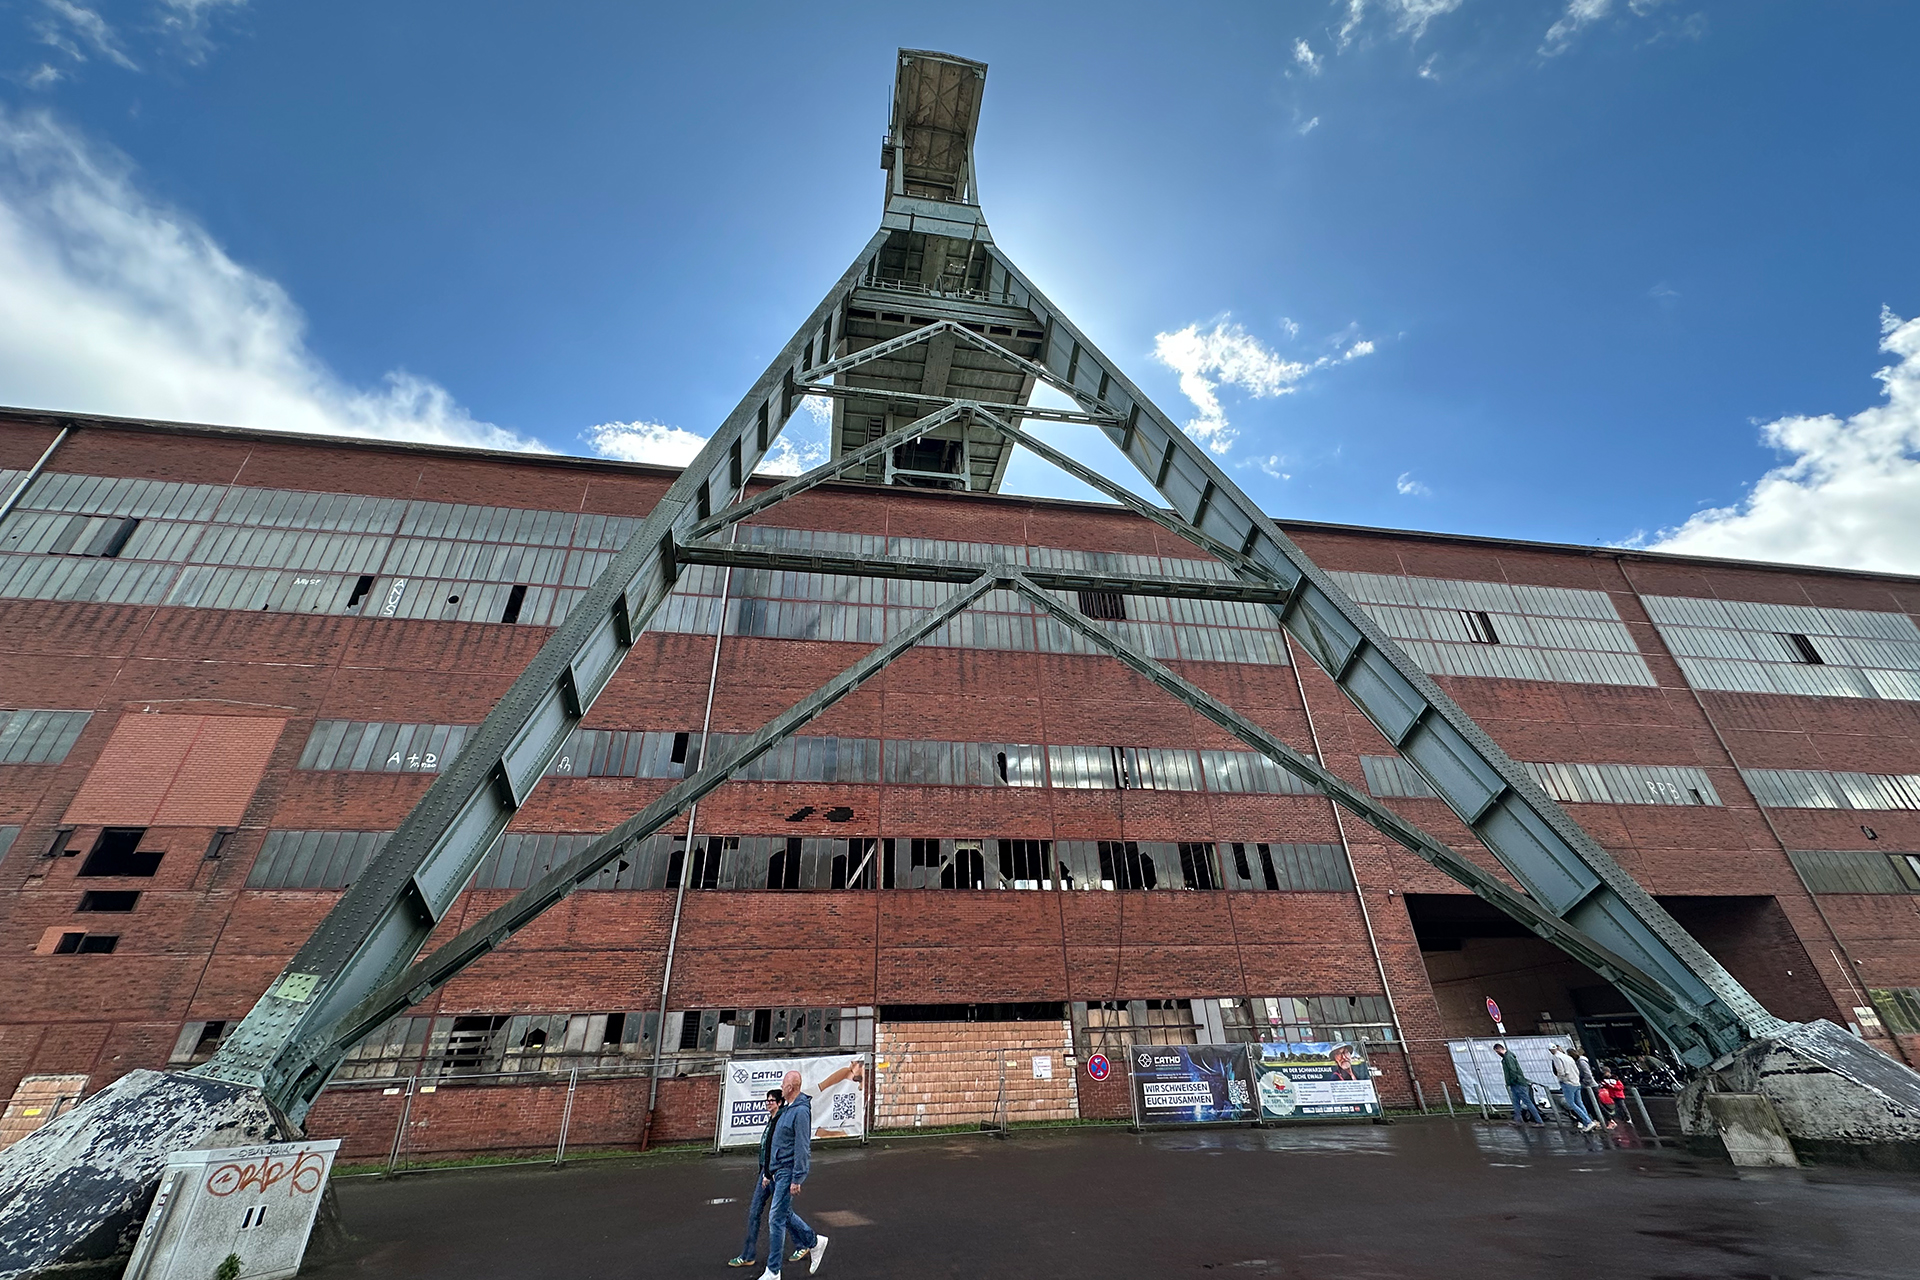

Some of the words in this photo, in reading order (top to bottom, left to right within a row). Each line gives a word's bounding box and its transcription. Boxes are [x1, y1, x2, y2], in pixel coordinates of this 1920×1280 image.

[383, 579, 405, 615] ANUS
[387, 752, 400, 765] A
[426, 753, 437, 763] D
[1646, 781, 1679, 799] RPB
[1145, 1084, 1160, 1093] WIR
[1162, 1083, 1208, 1092] SCHWEISSEN
[1147, 1097, 1167, 1105] EUCH
[1168, 1095, 1212, 1105] ZUSAMMEN
[734, 1102, 751, 1111] WIR
[752, 1101, 767, 1110] MA
[733, 1116, 751, 1125] DAS
